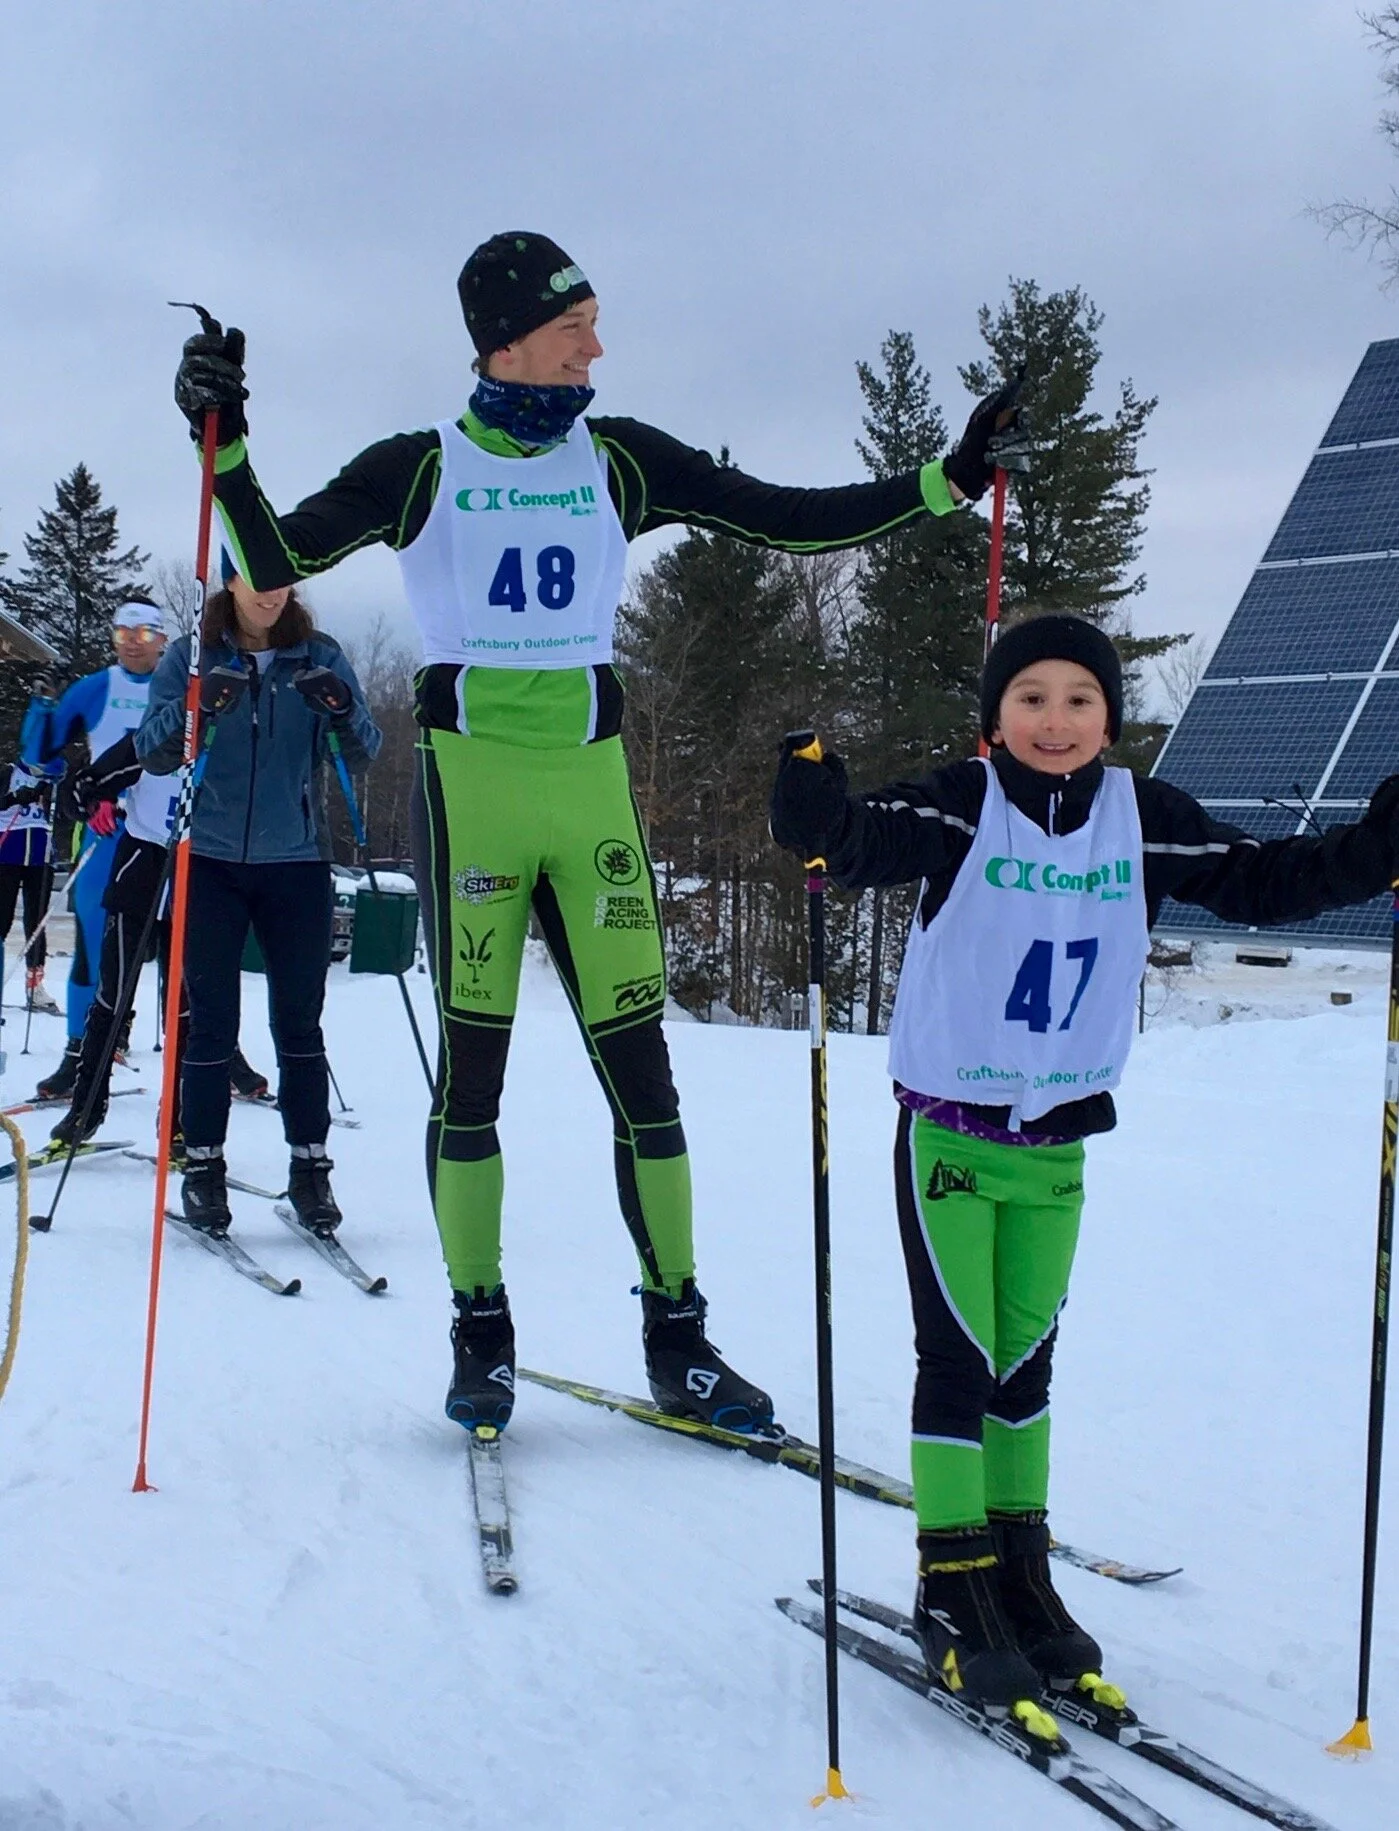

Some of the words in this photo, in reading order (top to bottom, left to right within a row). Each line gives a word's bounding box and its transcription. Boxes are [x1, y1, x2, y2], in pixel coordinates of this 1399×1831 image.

[508, 488, 577, 509] Concept
[488, 545, 575, 612] 48
[461, 637, 520, 651] Craftsbury
[524, 636, 570, 649] Outdoor
[185, 710, 193, 739] WORLD
[184, 741, 192, 760] CUP
[466, 878, 518, 892] SkiErg
[596, 896, 644, 907] GREEN
[595, 907, 649, 918] RACING
[594, 918, 657, 930] PROJECT
[455, 984, 492, 1001] ibex
[1004, 937, 1098, 1034] 47
